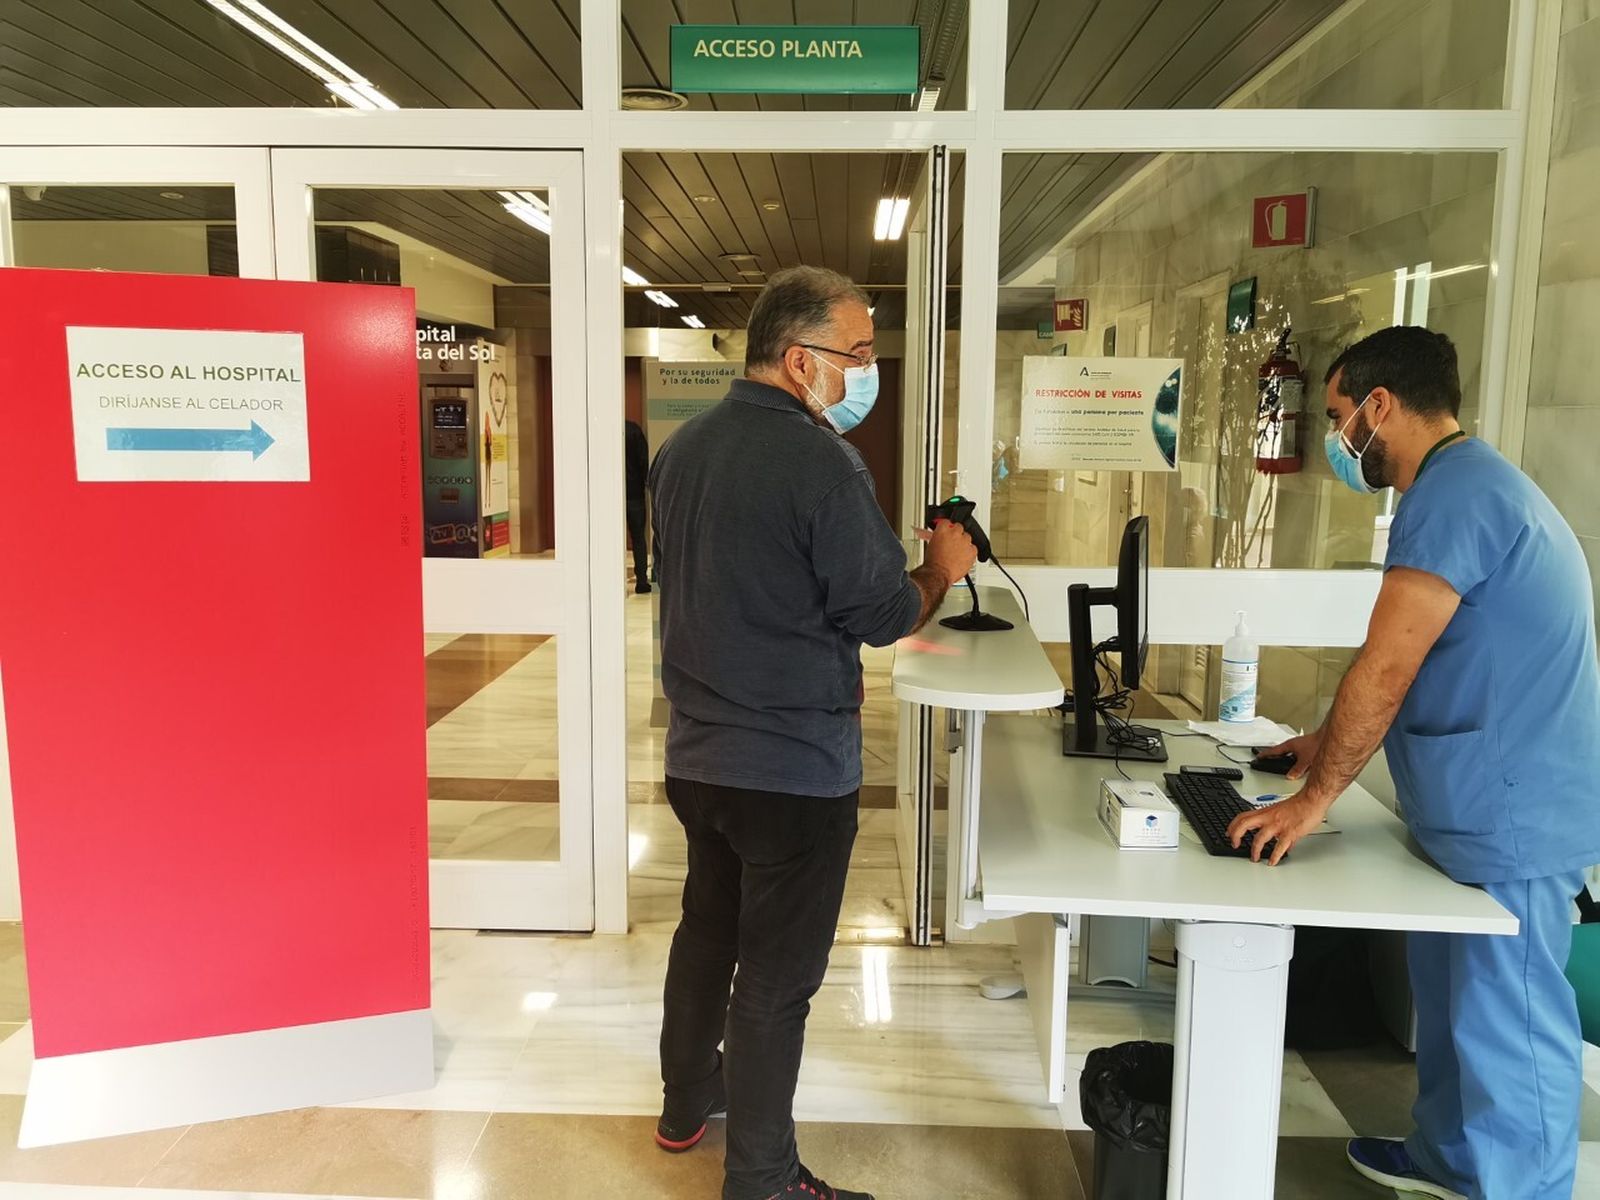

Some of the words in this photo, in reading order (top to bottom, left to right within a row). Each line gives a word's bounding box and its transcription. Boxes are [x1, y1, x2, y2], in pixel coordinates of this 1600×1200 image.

[693, 39, 776, 59] ACCESO
[782, 40, 863, 59] PLANTA
[437, 344, 464, 360] del
[469, 344, 495, 360] Sol
[76, 363, 165, 379] ACCESO
[170, 365, 197, 380] AL
[203, 366, 302, 383] HOSPITAL
[659, 368, 676, 376] Por
[691, 368, 736, 378] seguridad
[670, 377, 679, 385] la
[681, 377, 693, 385] de
[695, 377, 721, 385] todos
[1035, 388, 1091, 399] RESTRICCIÓN
[1095, 389, 1107, 399] DE
[1111, 390, 1142, 399] VISITAS
[186, 397, 206, 410] AL
[209, 398, 284, 411] CELADOR
